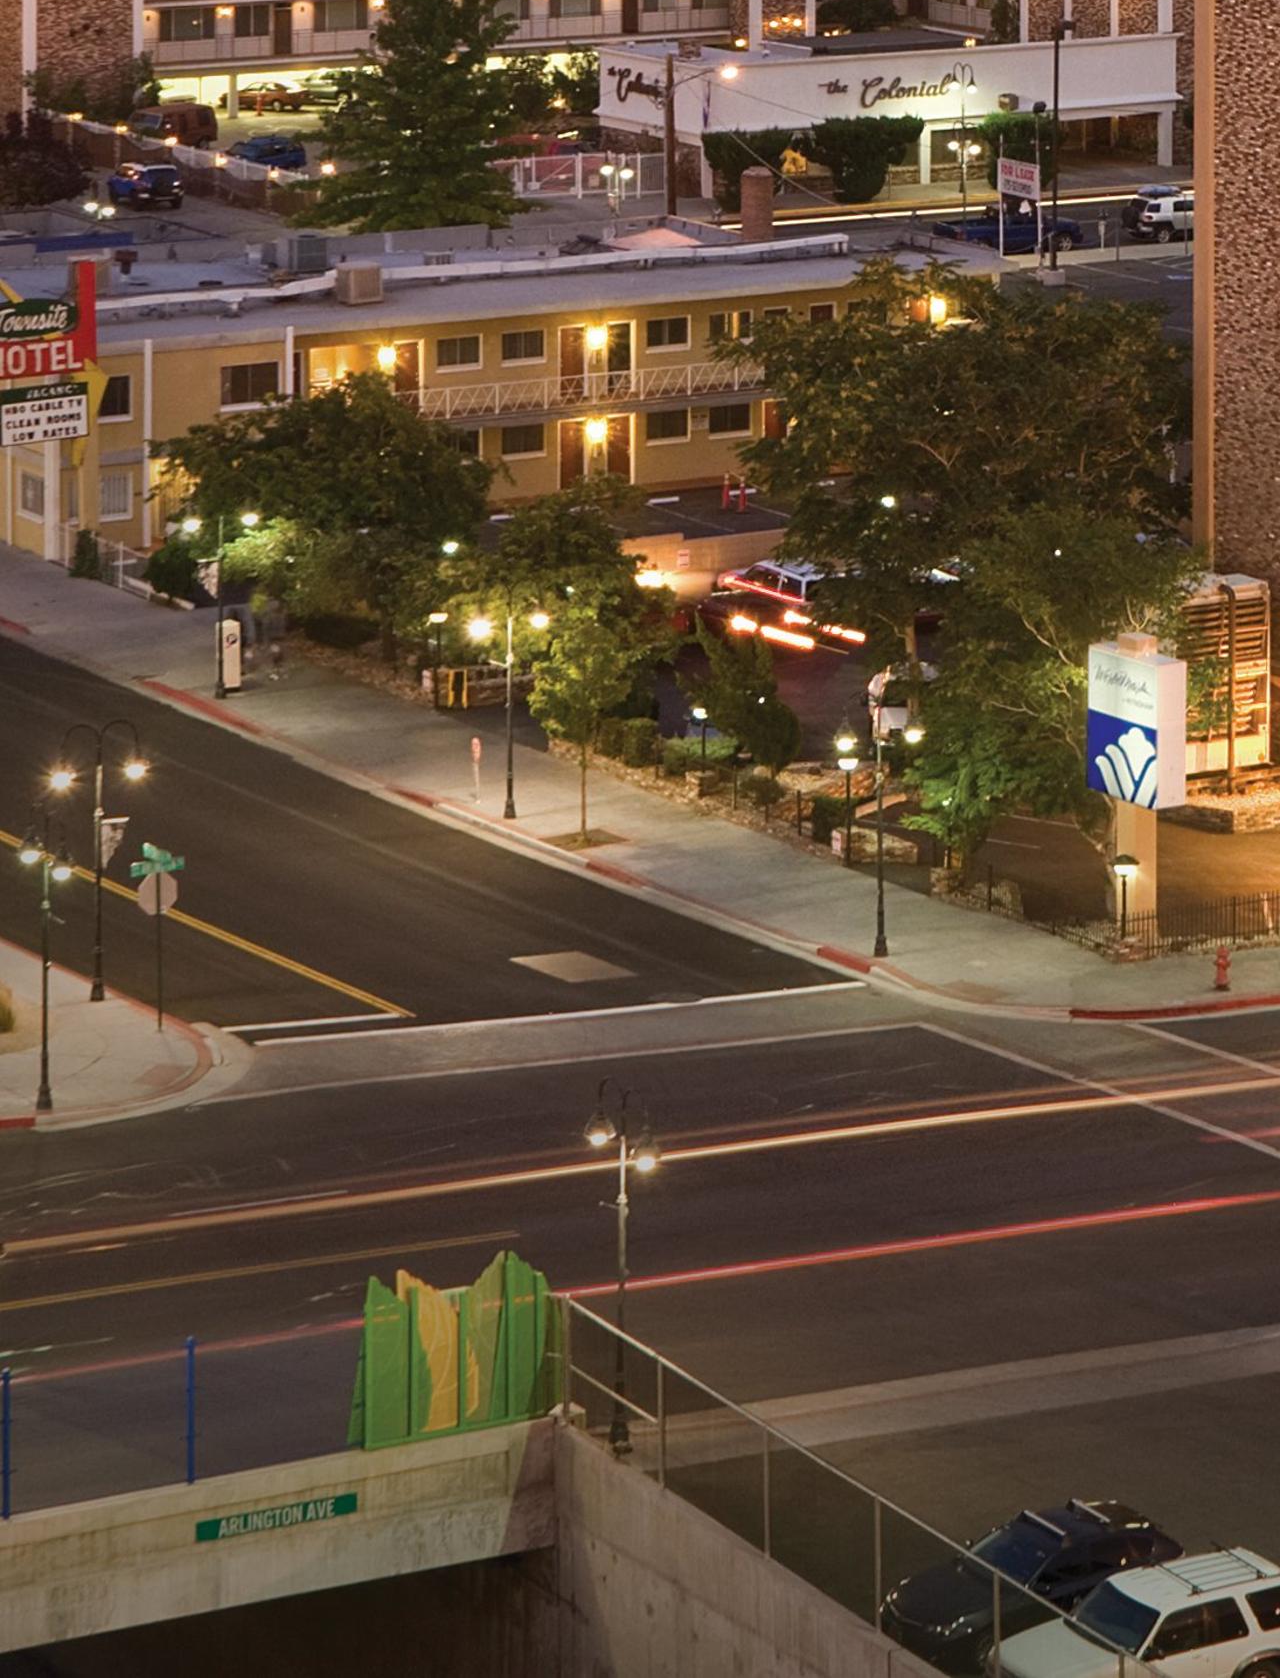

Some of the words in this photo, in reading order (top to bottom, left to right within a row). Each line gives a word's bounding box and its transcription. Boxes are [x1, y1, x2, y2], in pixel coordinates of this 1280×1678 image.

[818, 78, 848, 94] the
[861, 75, 953, 108] Colonial
[0, 340, 83, 376] OTEL
[5, 405, 26, 415] HBO
[31, 401, 63, 413] CABLE
[68, 398, 82, 408] TV
[6, 418, 40, 430] CLEAN
[47, 412, 82, 424] ROOMS
[12, 432, 34, 442] LOW
[43, 426, 78, 438] RATES
[218, 1505, 303, 1538] ARLINGTON
[305, 1498, 336, 1521] AVE
